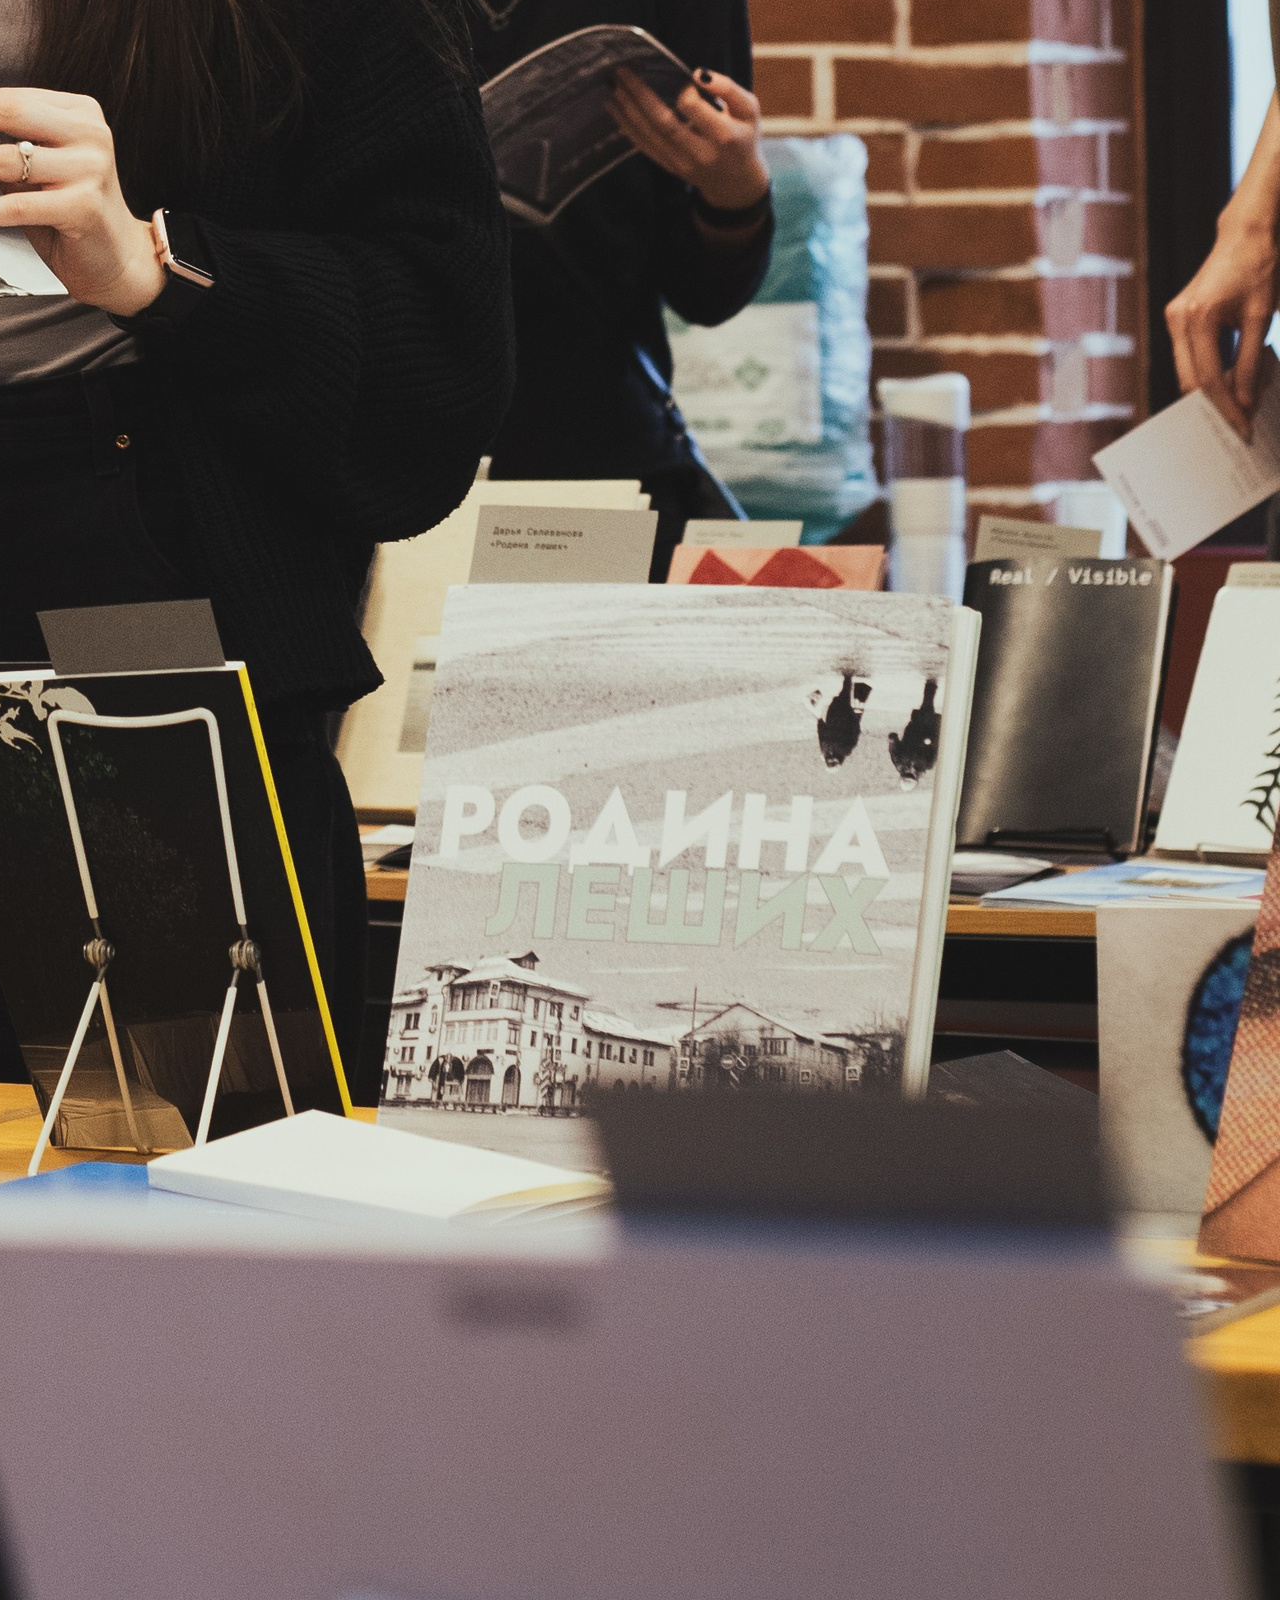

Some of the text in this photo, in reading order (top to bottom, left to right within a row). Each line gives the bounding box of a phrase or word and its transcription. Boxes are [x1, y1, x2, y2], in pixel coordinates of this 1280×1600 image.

[492, 526, 522, 536] Дарья
[989, 567, 1034, 585] Real
[1068, 567, 1153, 586] Visible
[440, 784, 890, 878] РОДИНА
[485, 863, 889, 955] ЛЕШИХ
